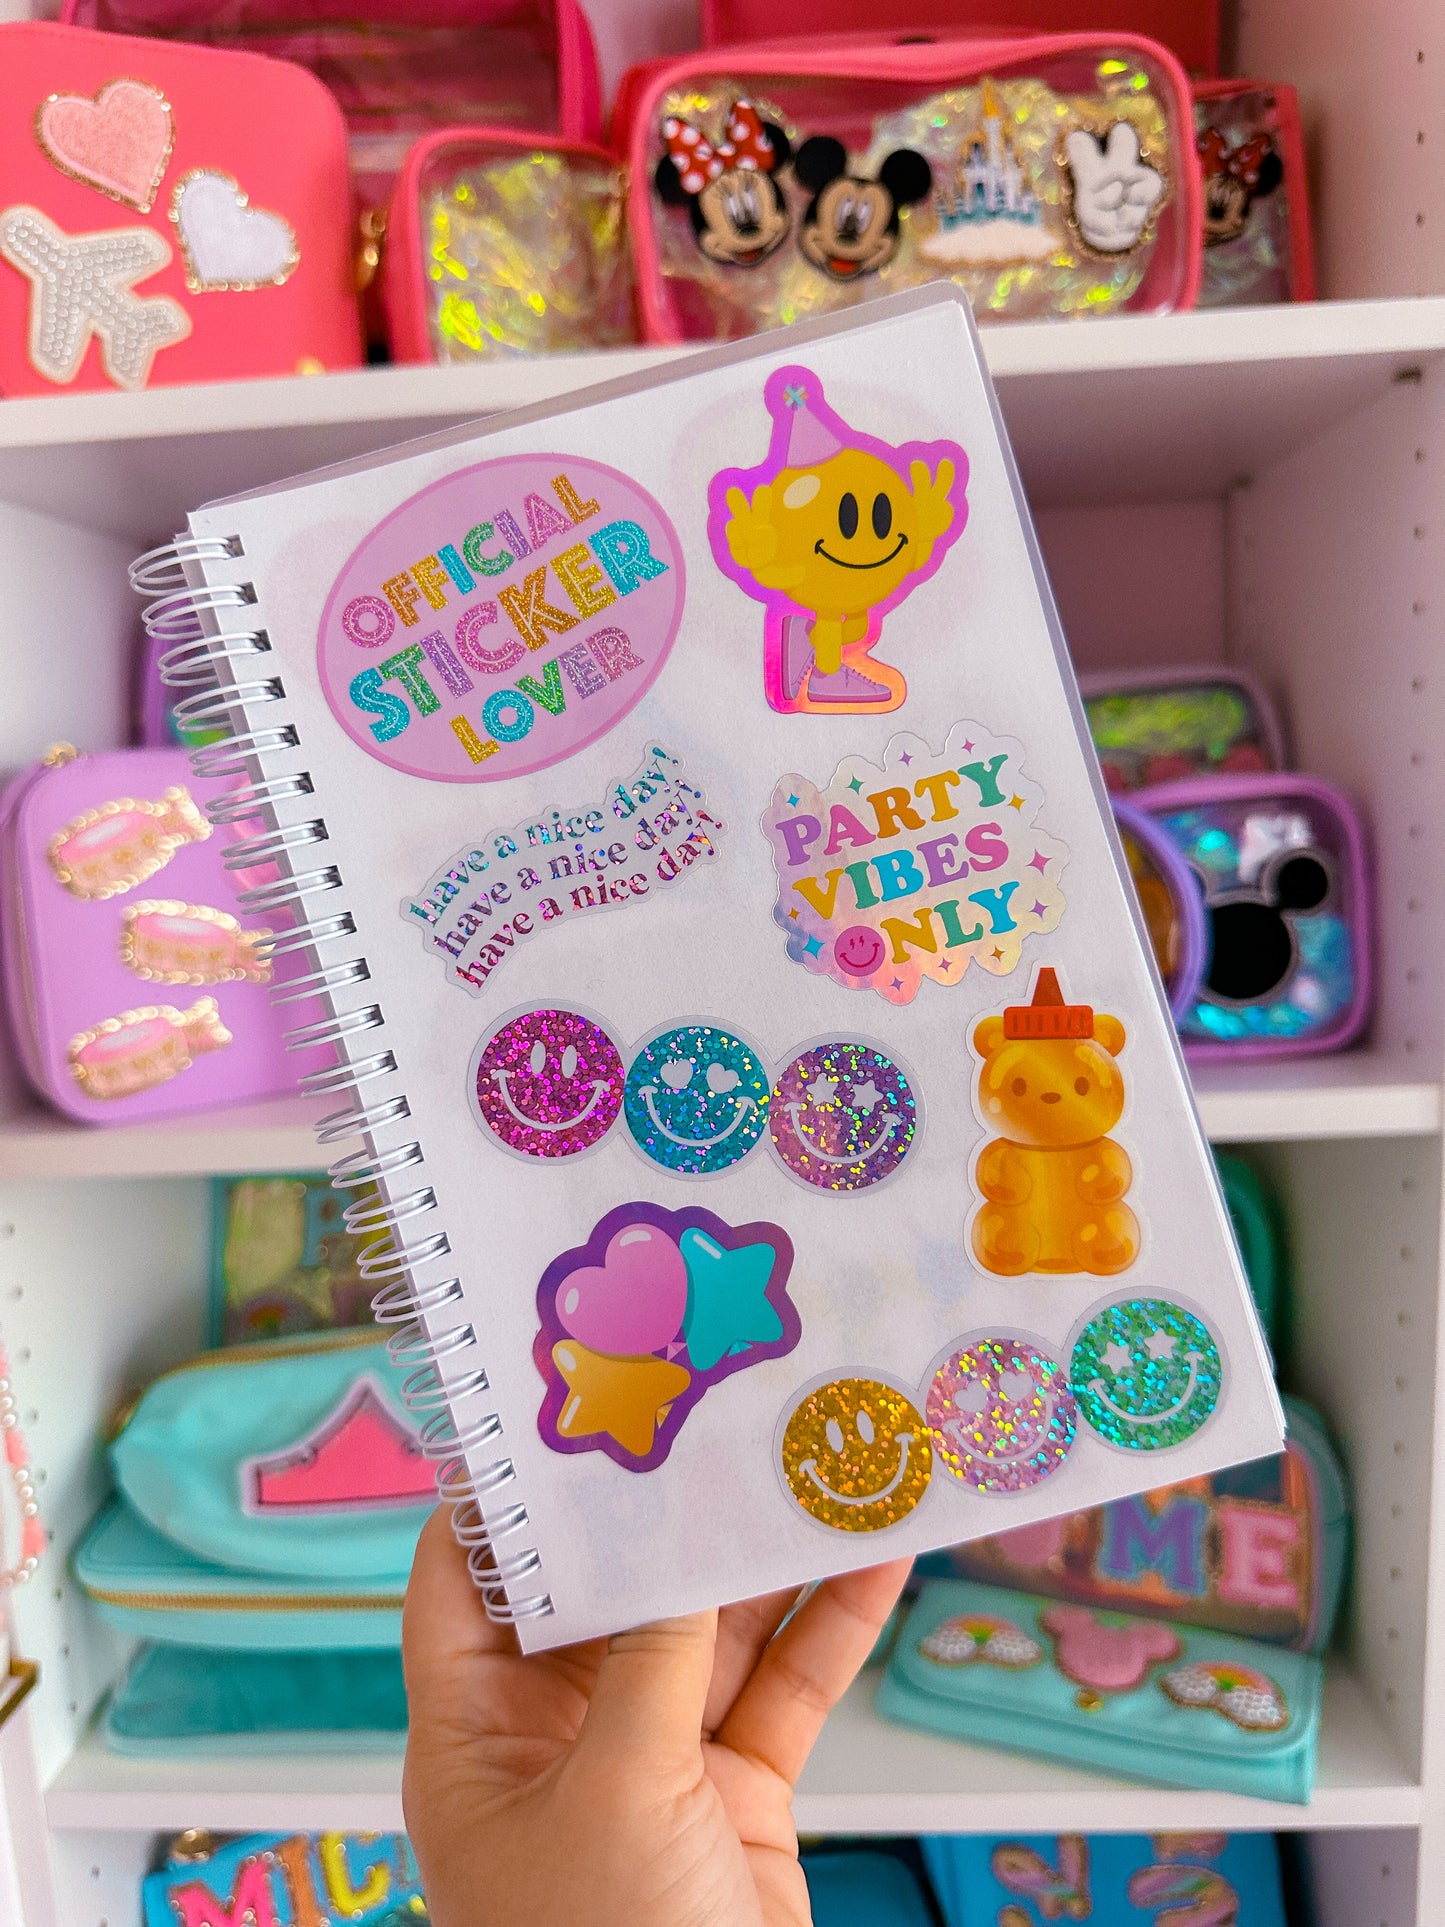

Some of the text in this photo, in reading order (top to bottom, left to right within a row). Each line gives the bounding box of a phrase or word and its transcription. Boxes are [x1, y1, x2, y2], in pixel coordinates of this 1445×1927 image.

[342, 473, 600, 649] OFFICIAL
[349, 519, 669, 743] STICKER
[449, 626, 645, 765] LOVER
[409, 747, 678, 927] have a nice day!
[433, 779, 701, 959] have a nice day!
[775, 753, 1009, 866] PARTY
[792, 822, 1009, 920] VIBES
[455, 809, 722, 989] have a nice day!
